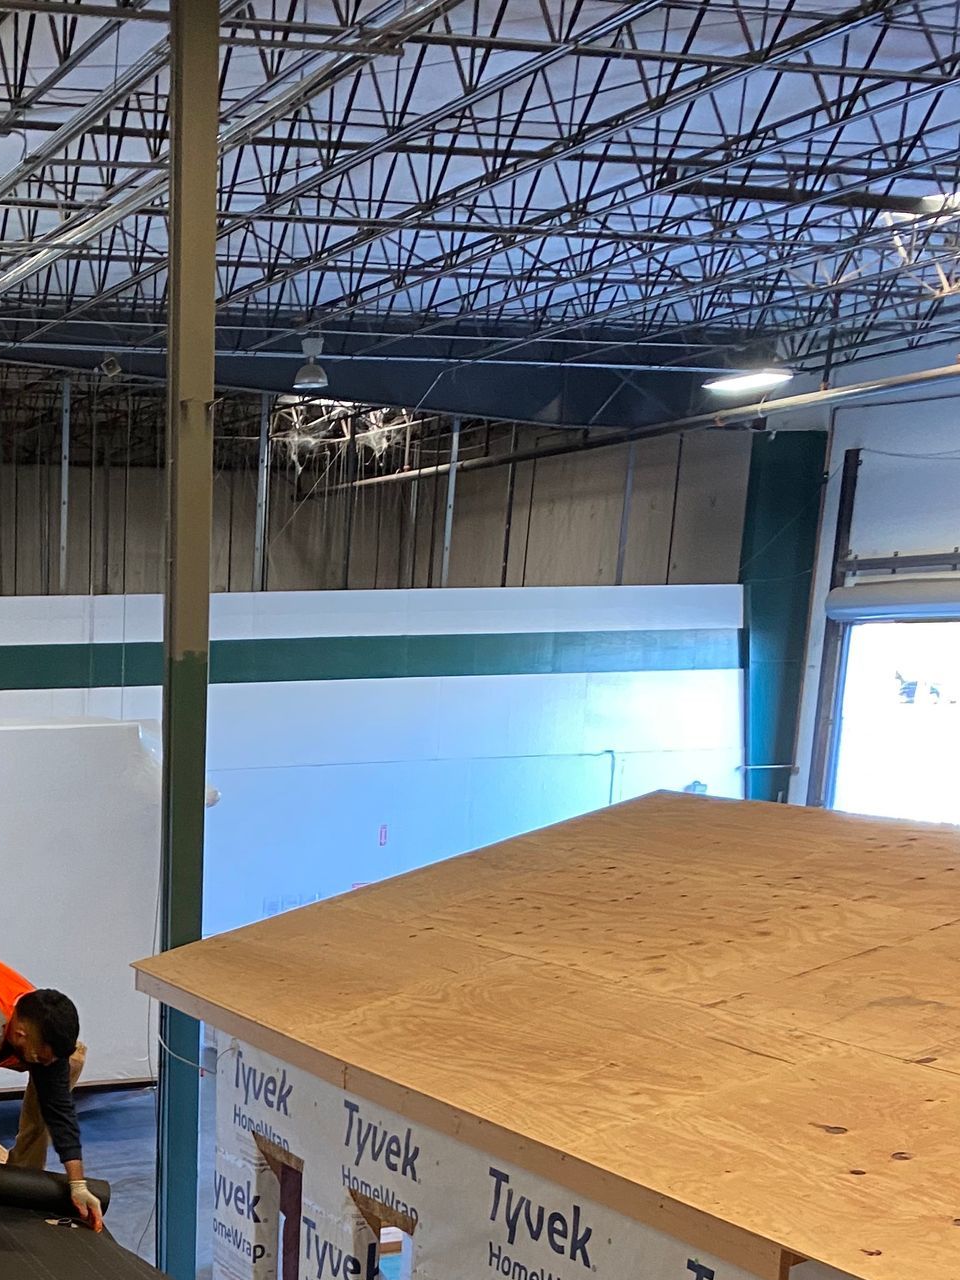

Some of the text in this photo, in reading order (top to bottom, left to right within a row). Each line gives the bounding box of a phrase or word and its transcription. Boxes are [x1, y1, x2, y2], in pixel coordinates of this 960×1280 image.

[344, 1099, 420, 1181] Tyvek
[342, 1165, 419, 1225] HomeWrap
[489, 1167, 592, 1268] Tyvek
